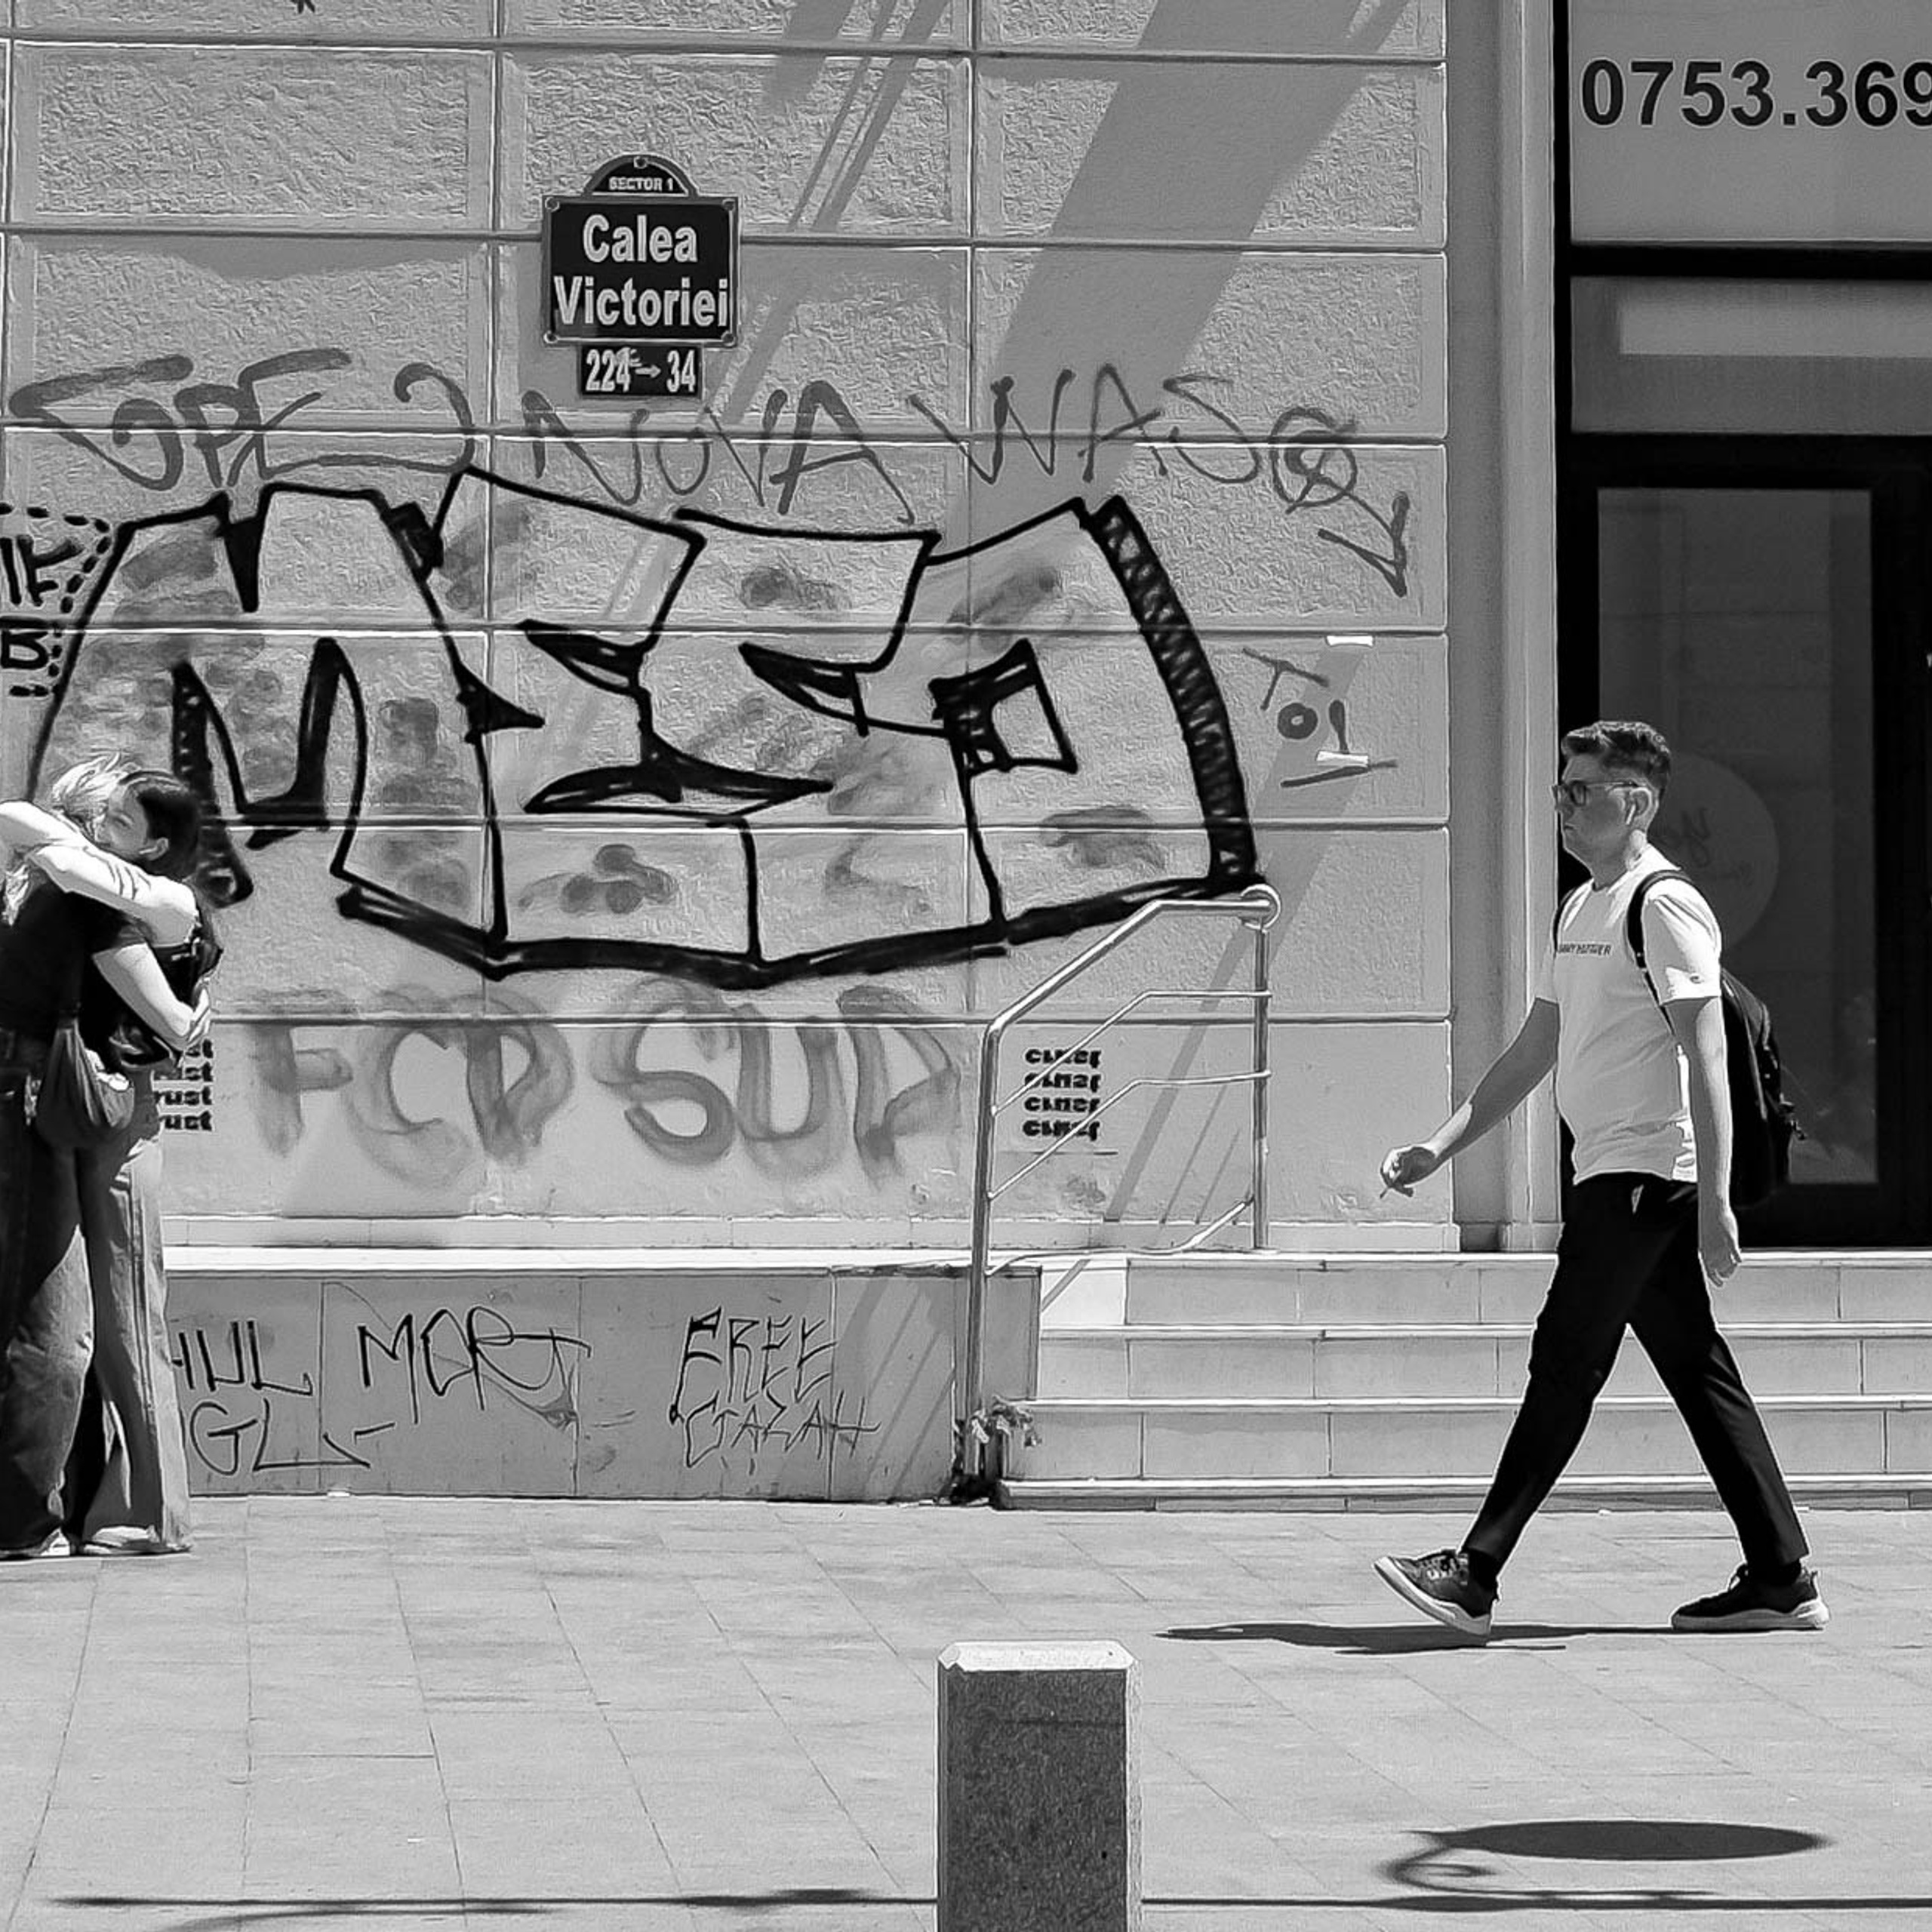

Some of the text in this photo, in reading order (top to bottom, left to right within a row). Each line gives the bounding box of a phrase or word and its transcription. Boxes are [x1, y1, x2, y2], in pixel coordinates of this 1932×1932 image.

[1582, 59, 1932, 127] 0753.369
[609, 177, 674, 191] SECTOR 1
[583, 214, 697, 263] Calea
[553, 275, 728, 327] Victoriei
[666, 349, 696, 392] 34
